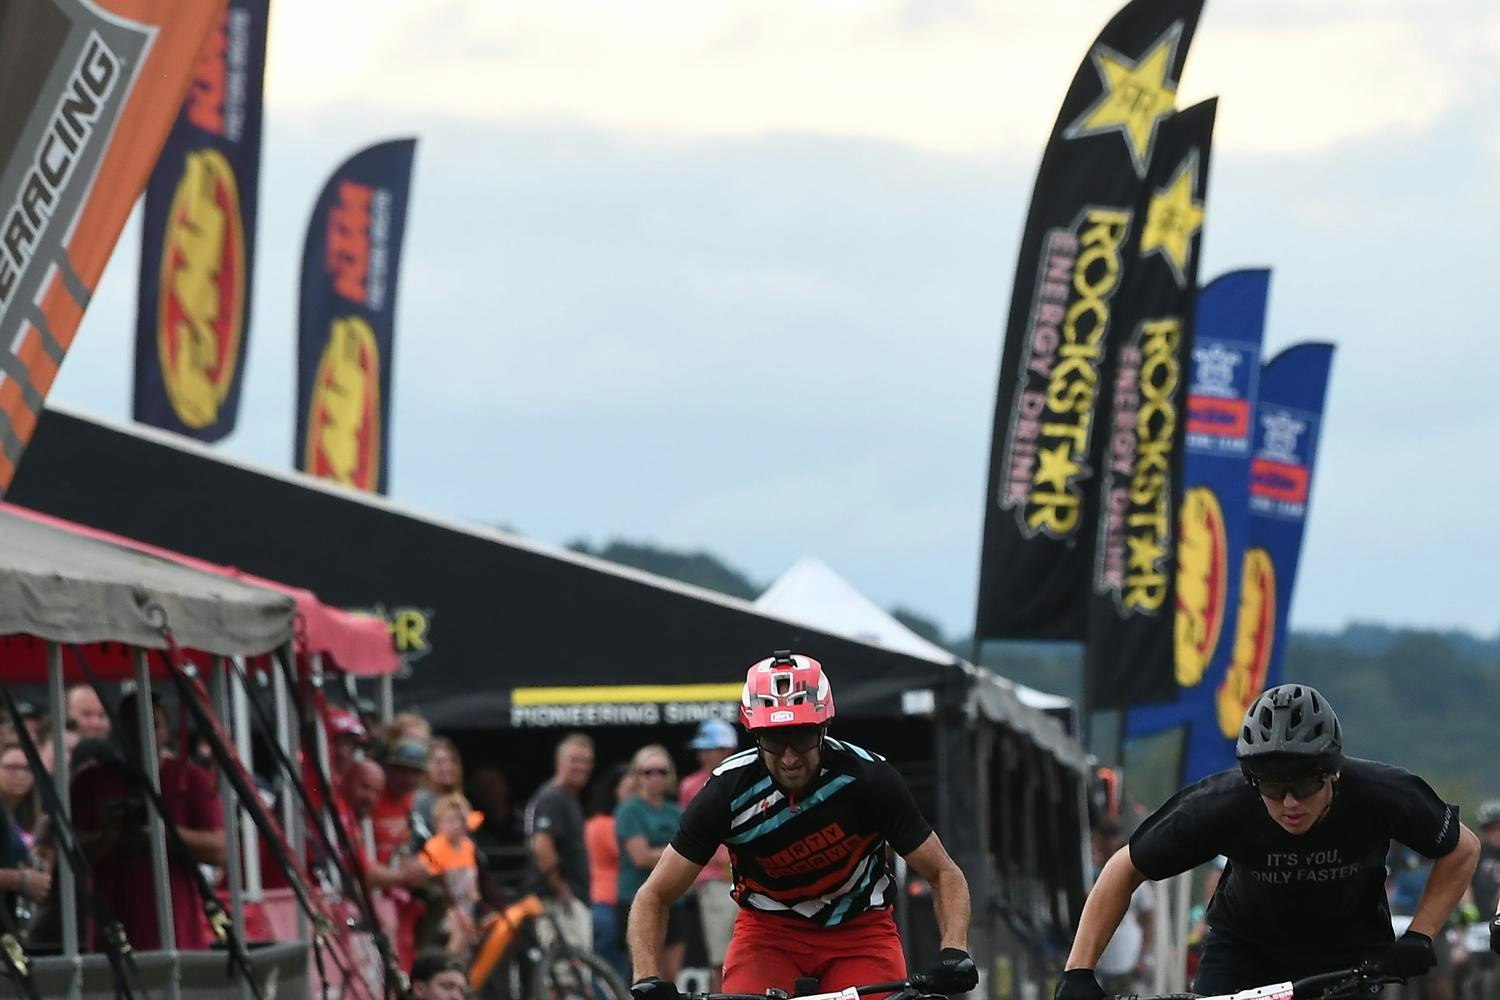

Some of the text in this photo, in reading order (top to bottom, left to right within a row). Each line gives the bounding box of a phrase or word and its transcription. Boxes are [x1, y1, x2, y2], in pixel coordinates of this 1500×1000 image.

[510, 701, 739, 728] PIONEERING SINCE
[1267, 852, 1299, 867] IT'S
